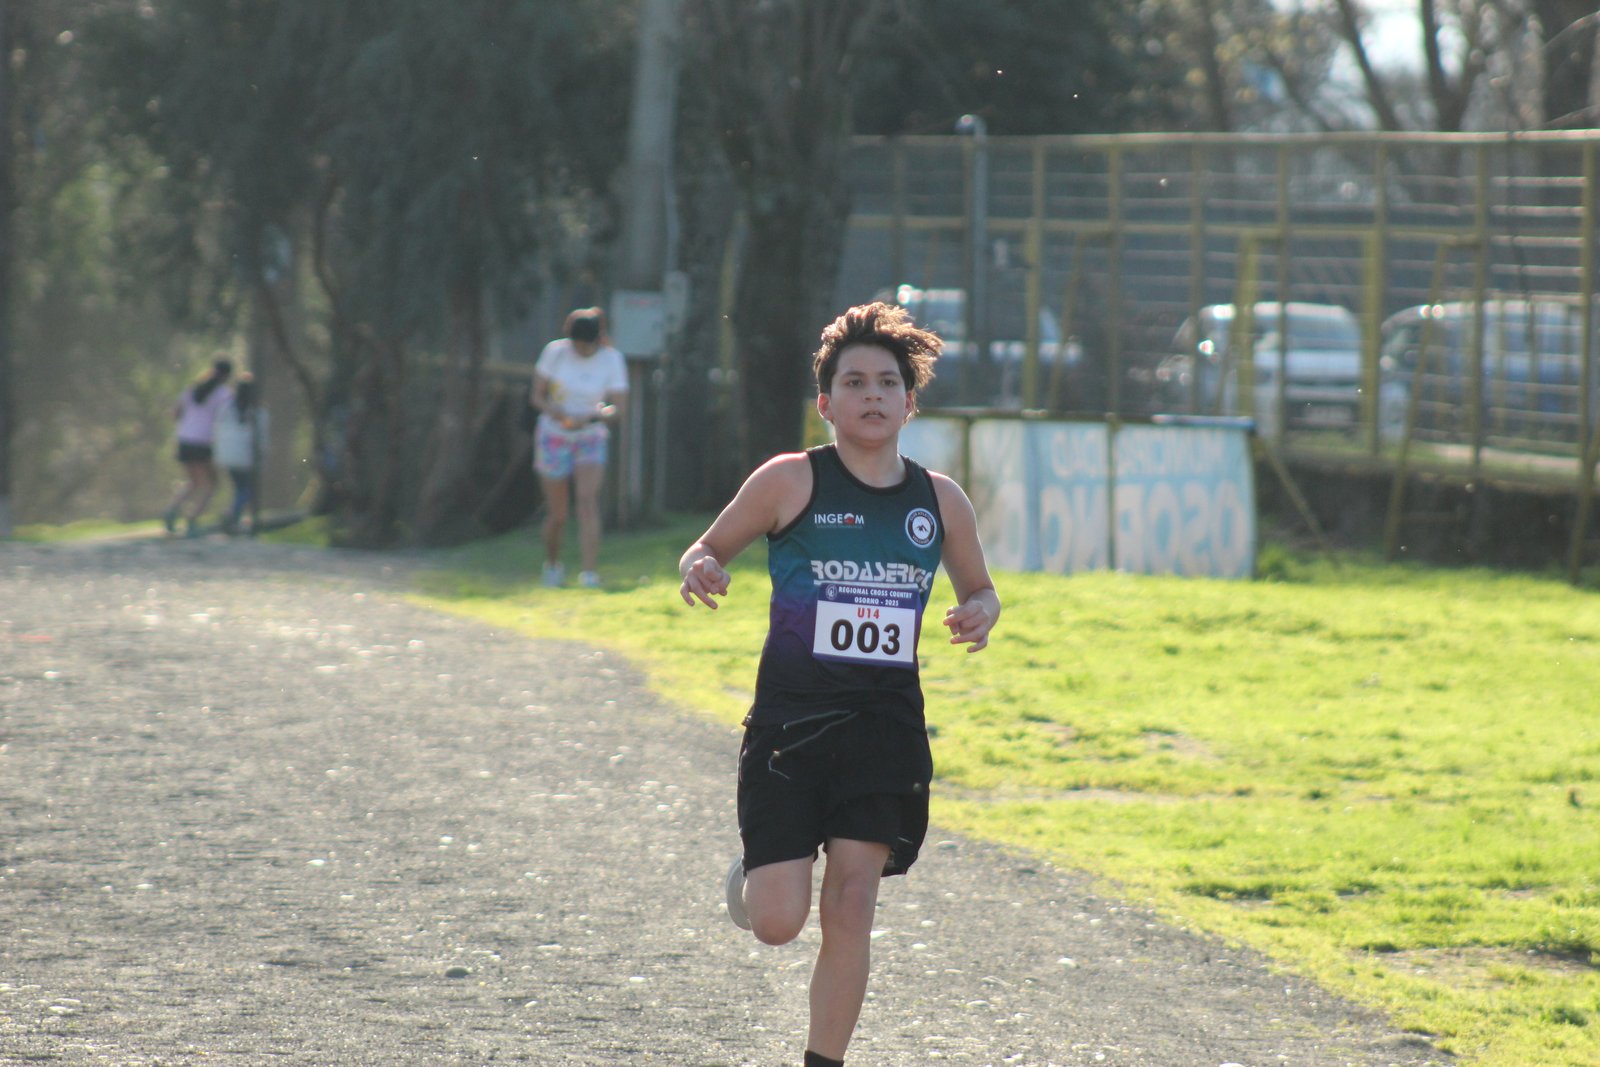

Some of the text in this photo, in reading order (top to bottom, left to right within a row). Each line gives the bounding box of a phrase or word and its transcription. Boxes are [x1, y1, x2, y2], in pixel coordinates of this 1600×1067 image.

[838, 586, 913, 598] REGIONAL CROSS COUNTRY
[857, 608, 880, 618] U14
[830, 618, 900, 655] 003
